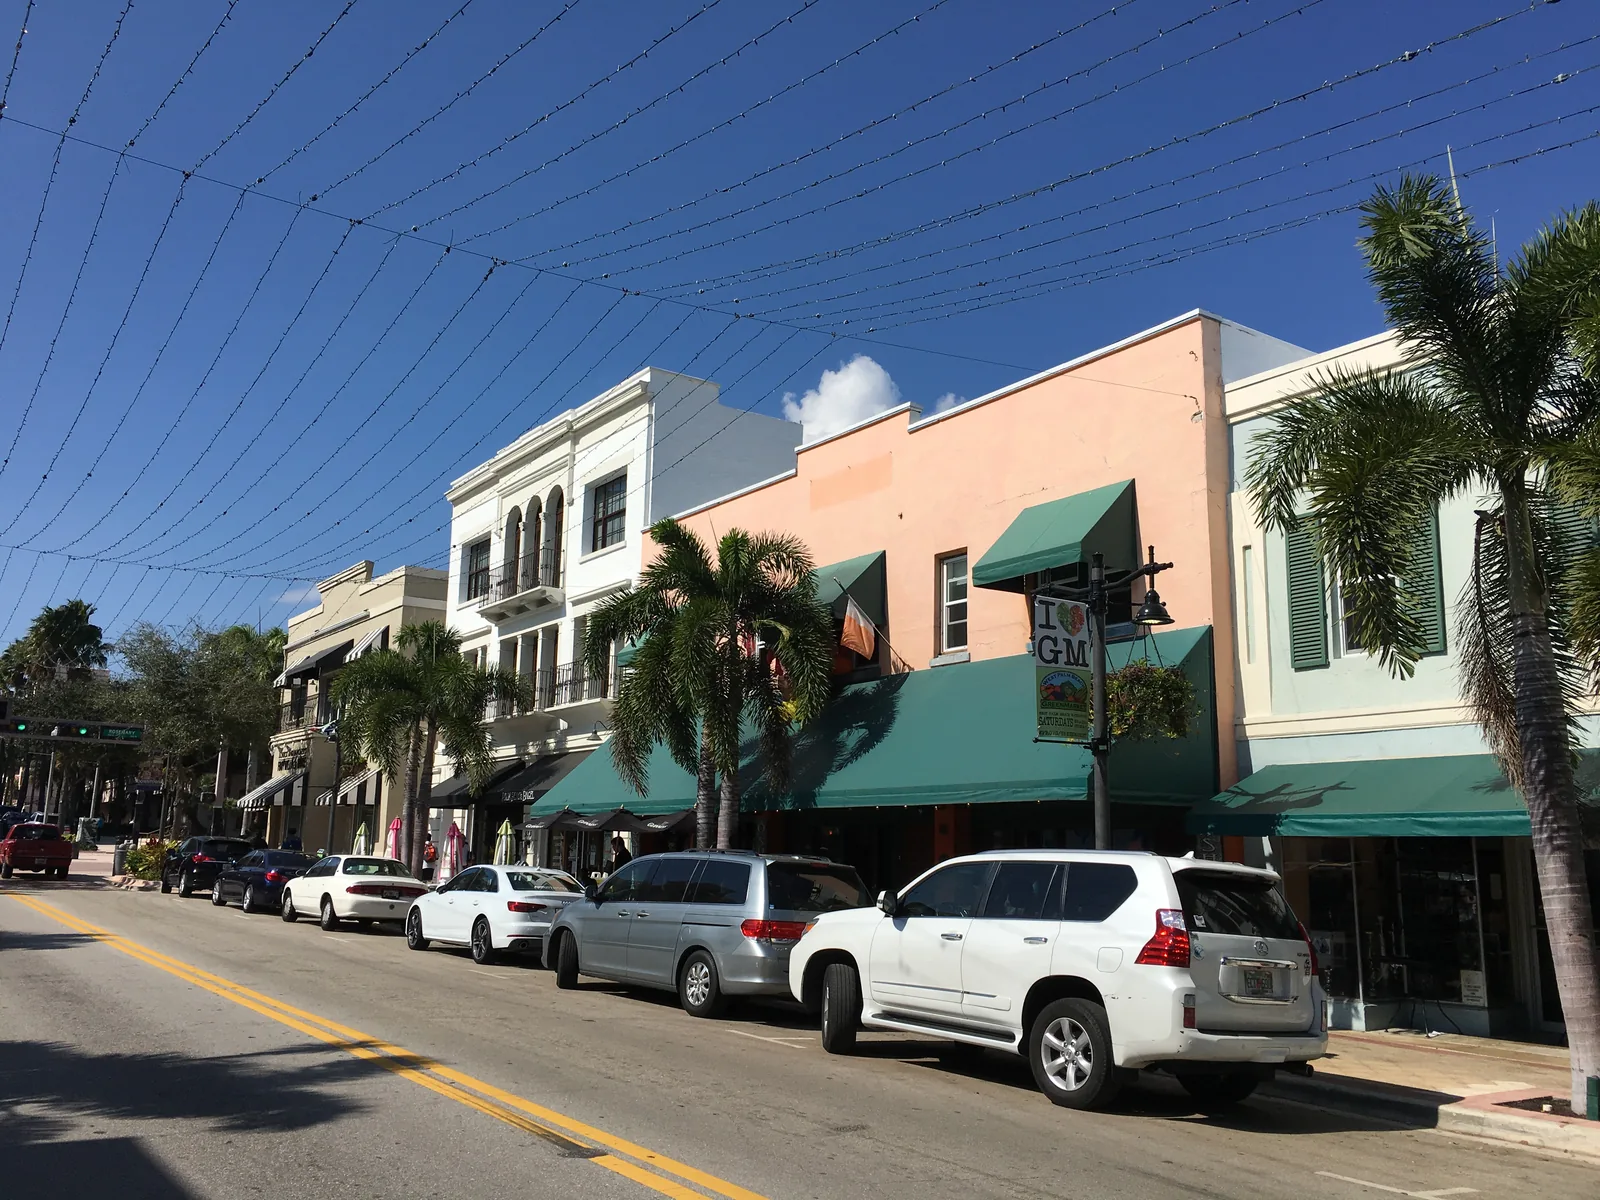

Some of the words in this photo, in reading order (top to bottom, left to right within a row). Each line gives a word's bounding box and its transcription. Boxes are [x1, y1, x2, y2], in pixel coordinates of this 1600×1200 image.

[1038, 600, 1057, 630] I
[1038, 635, 1089, 667] GM
[1042, 673, 1057, 686] WEST
[1039, 716, 1074, 728] SATURDAYS
